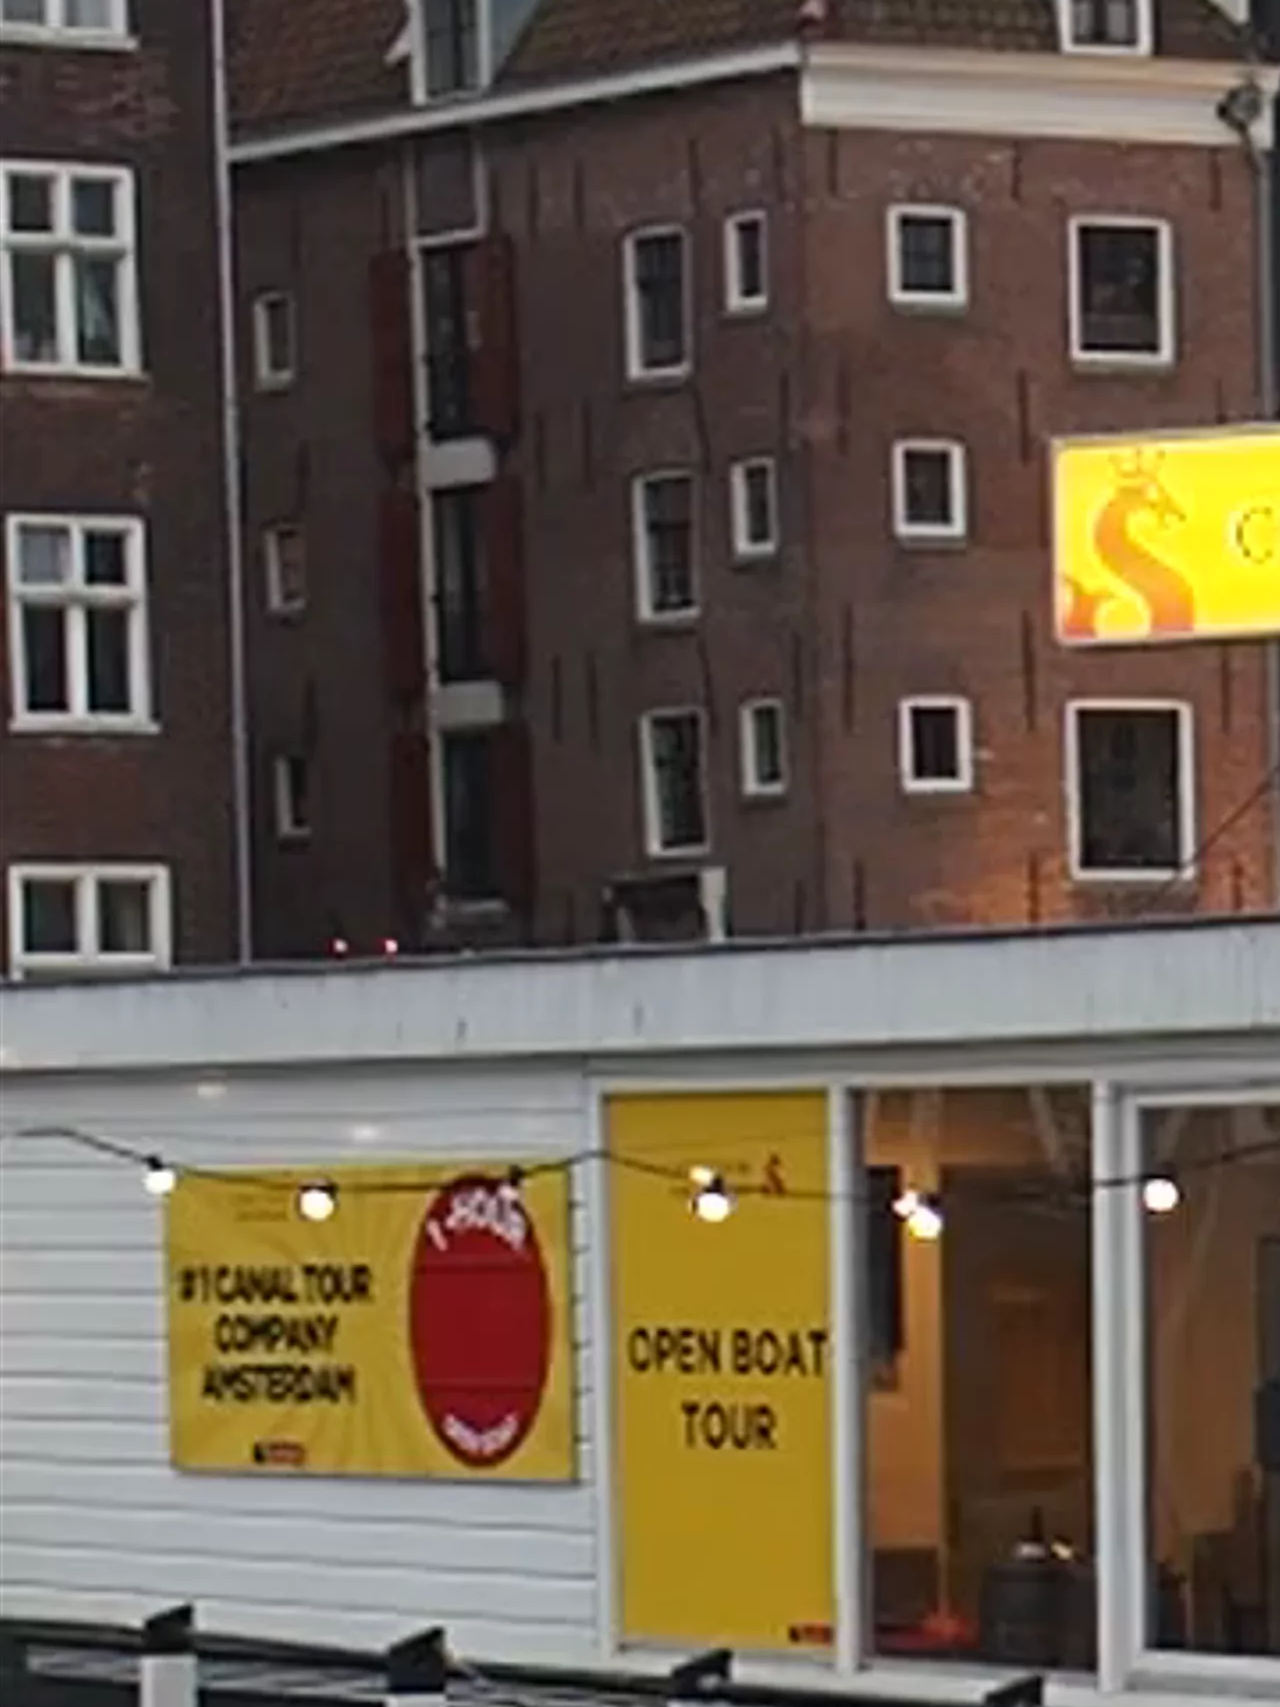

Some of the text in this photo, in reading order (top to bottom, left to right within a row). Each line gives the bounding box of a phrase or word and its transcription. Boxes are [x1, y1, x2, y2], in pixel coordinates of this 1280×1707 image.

[304, 1264, 373, 1304] TOUR
[214, 1314, 338, 1356] COMPANY
[628, 1325, 829, 1378] OPEN BOAT
[202, 1363, 356, 1404] AMSTERDAM
[681, 1400, 779, 1451] TOUR
